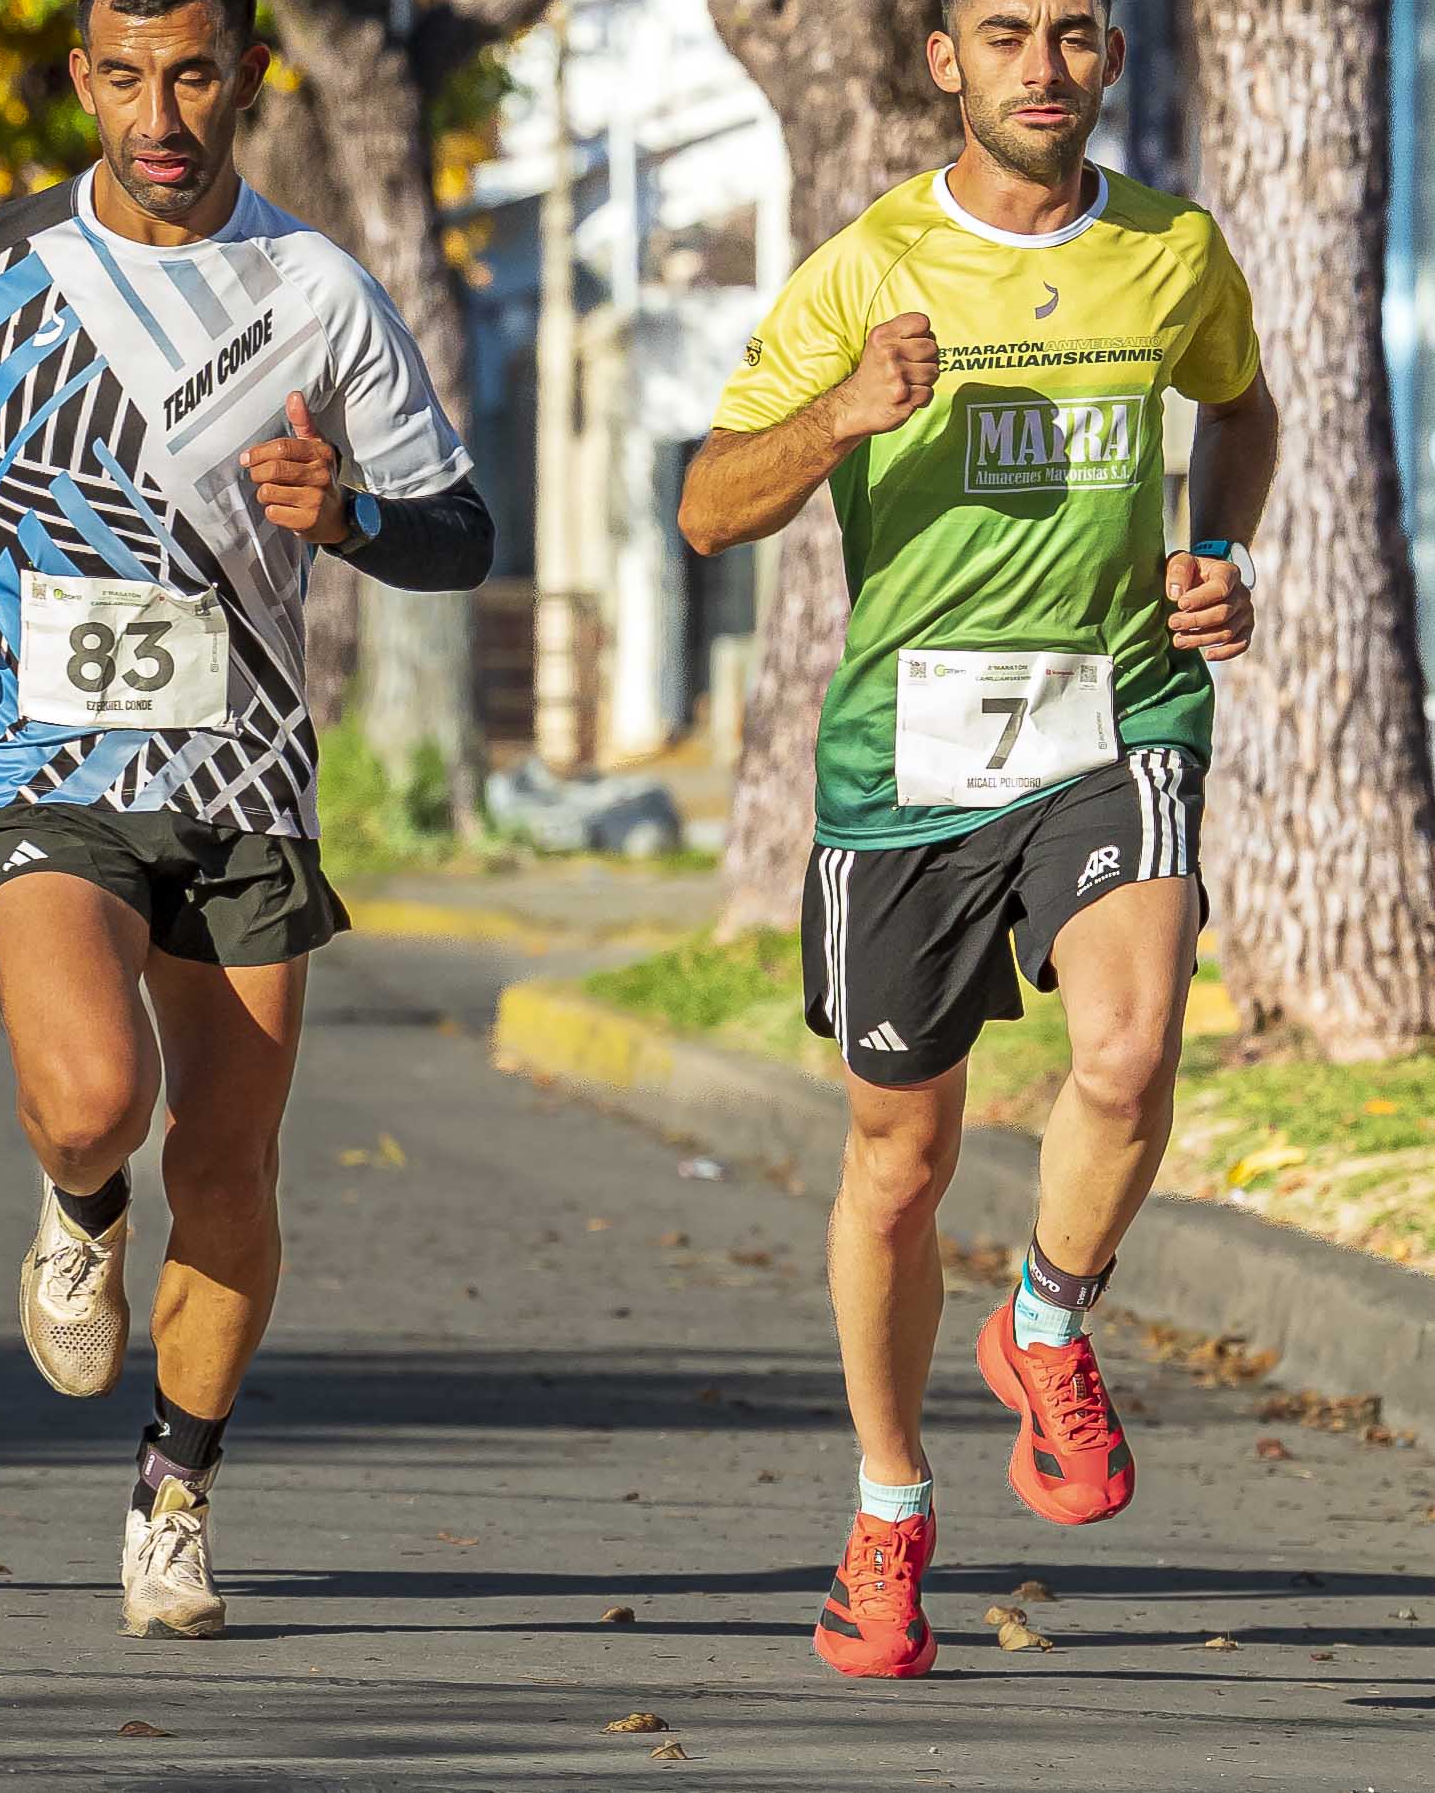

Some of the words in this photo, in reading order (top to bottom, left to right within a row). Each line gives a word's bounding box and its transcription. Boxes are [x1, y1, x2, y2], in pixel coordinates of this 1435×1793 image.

[1044, 335, 1162, 352] ANIVERSARIO
[164, 360, 213, 432] TEAM
[218, 308, 273, 385] CONDE
[976, 470, 1042, 486] Almacenes
[1046, 466, 1108, 482] Mayoristas
[67, 621, 175, 693] 83
[125, 699, 153, 711] CONDE
[982, 698, 1028, 769] 7
